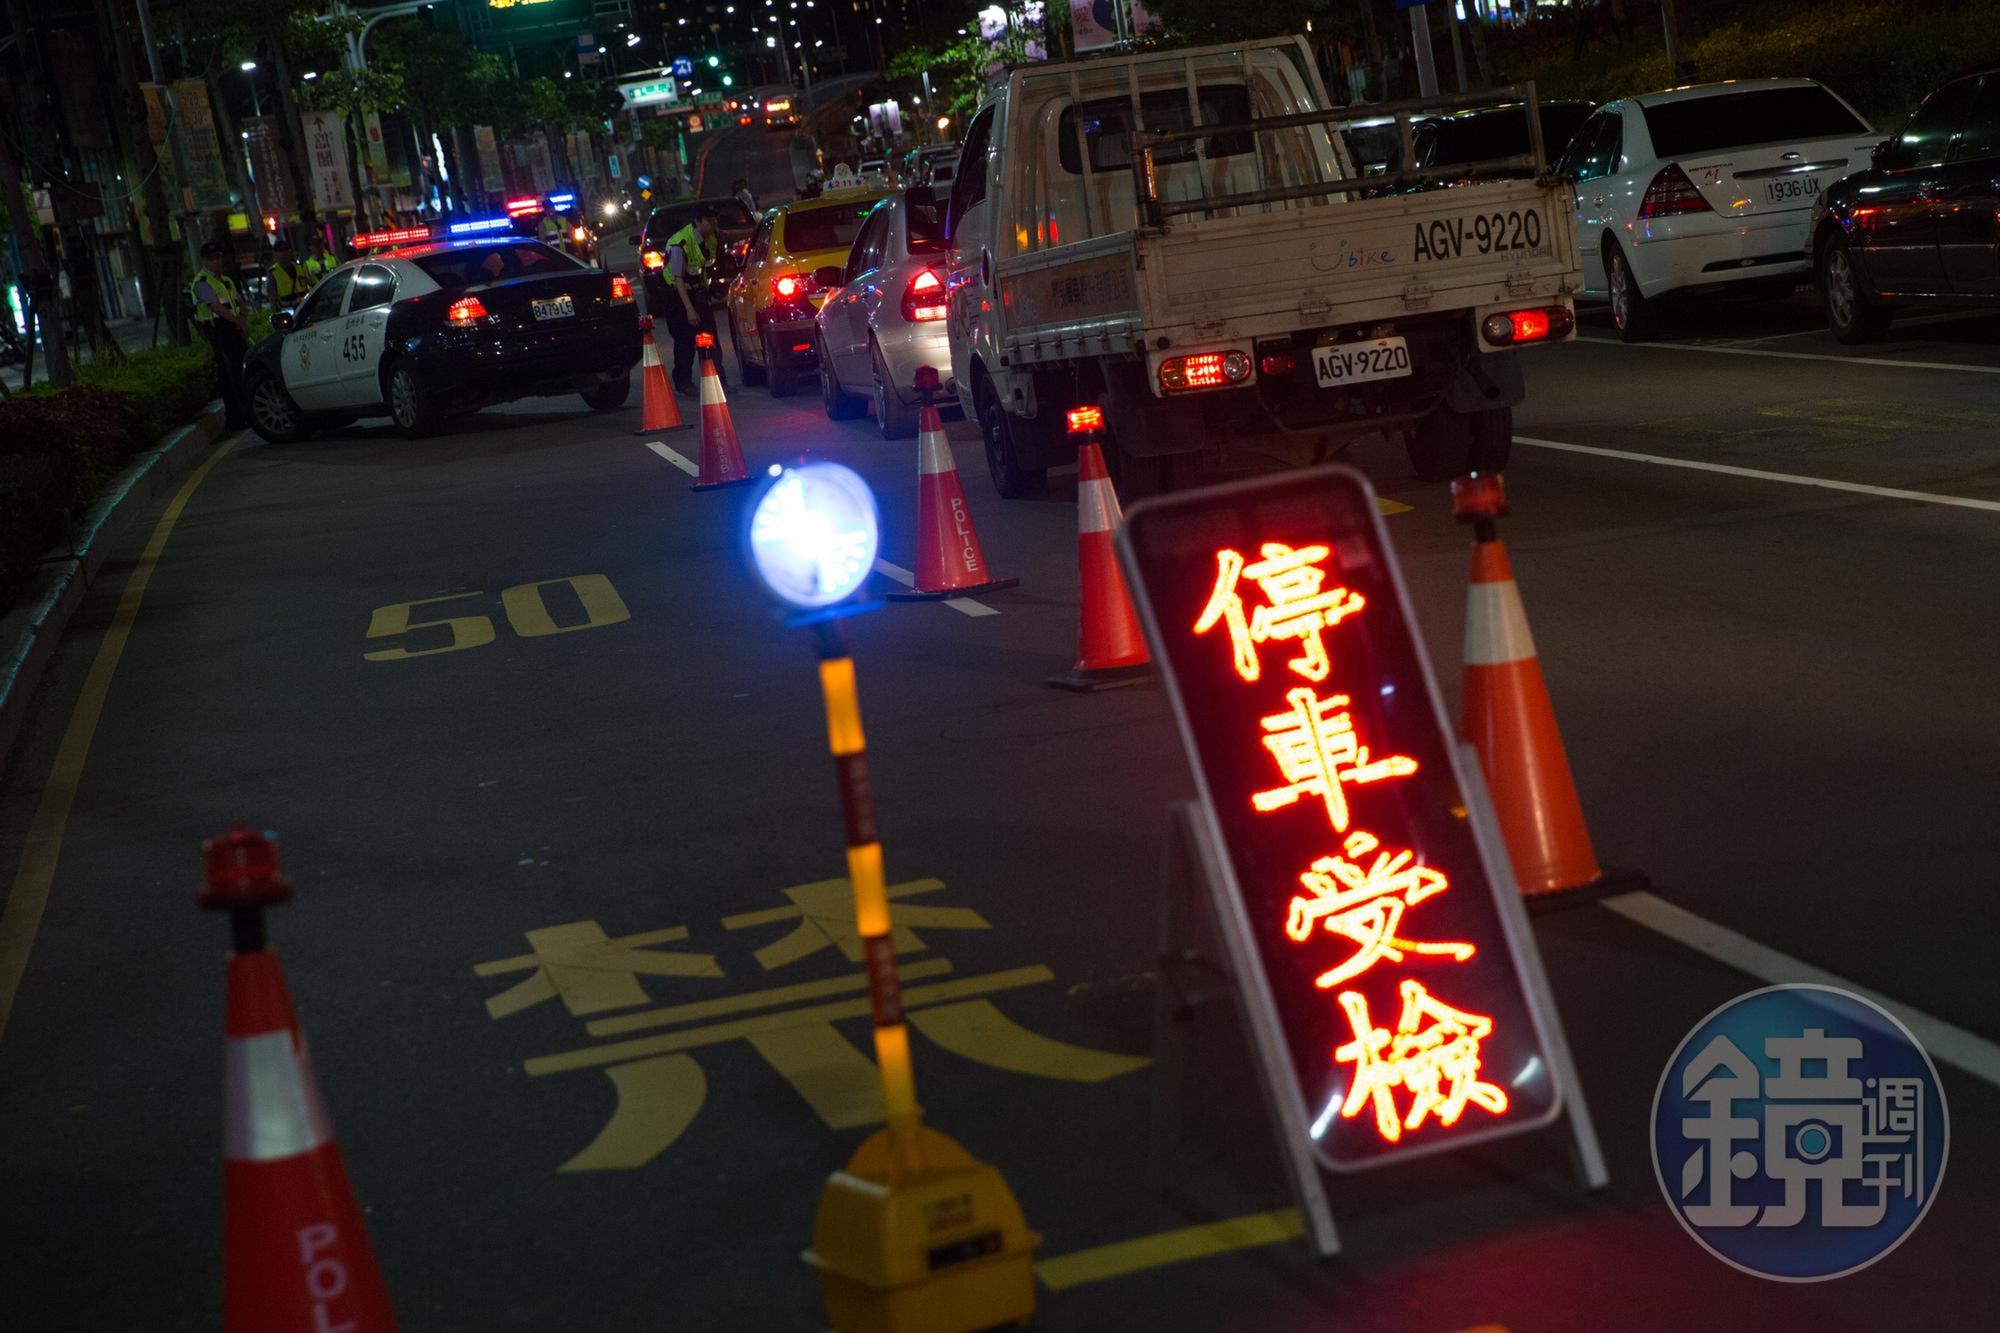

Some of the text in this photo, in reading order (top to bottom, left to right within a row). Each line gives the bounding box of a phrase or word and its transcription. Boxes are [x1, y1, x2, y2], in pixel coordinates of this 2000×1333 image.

[1414, 208, 1541, 262] AGV-9220
[343, 334, 366, 363] 455
[951, 497, 978, 573] POLICE
[363, 573, 631, 661] 50
[1194, 542, 1508, 1142] 停車受檢
